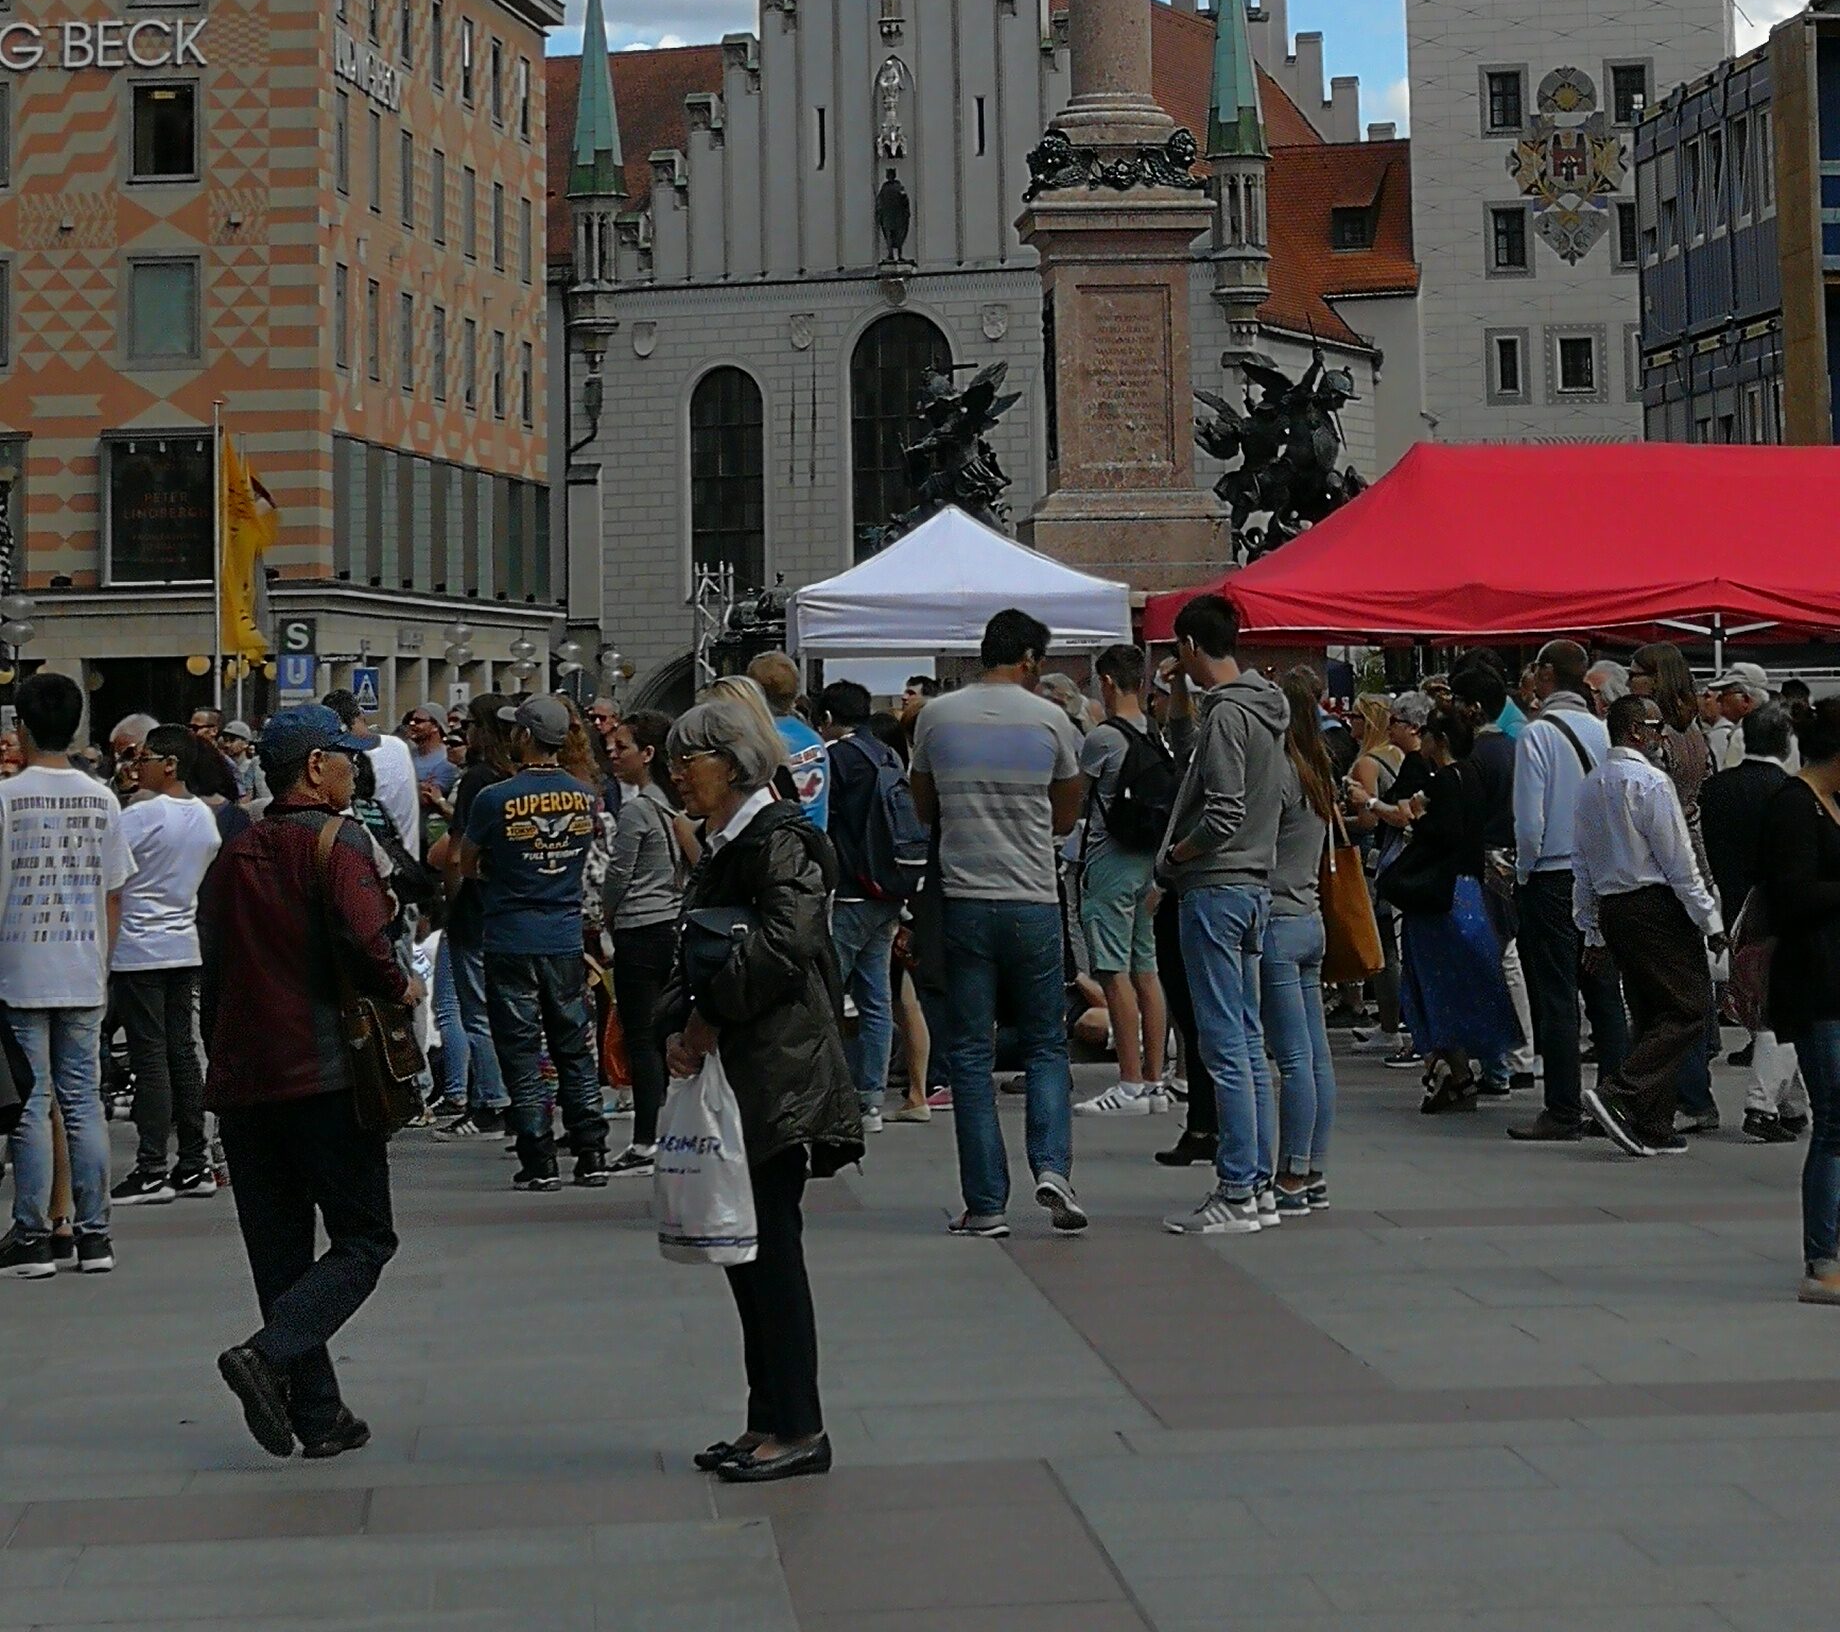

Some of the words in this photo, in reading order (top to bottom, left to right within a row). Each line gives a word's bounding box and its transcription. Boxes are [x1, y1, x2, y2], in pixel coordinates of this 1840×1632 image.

[63, 18, 208, 68] BECK
[286, 622, 310, 650] S
[287, 657, 308, 684] U
[505, 791, 594, 819] SUPERDRY
